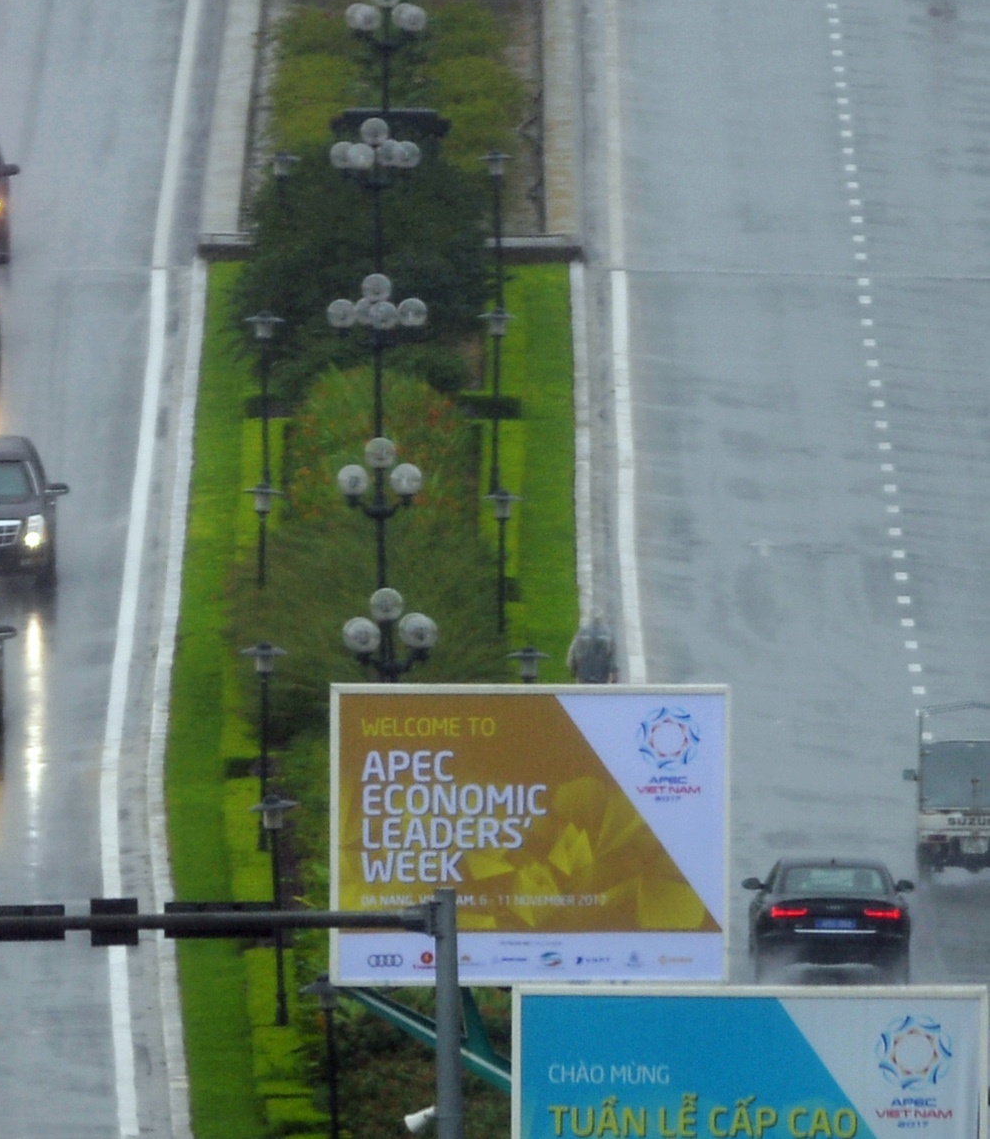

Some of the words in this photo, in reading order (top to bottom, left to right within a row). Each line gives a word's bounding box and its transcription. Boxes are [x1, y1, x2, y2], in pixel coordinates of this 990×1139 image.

[361, 717, 461, 737] WELCOME
[468, 717, 497, 737] TO
[361, 750, 455, 782] APEC
[362, 783, 548, 816] ECONOMIC
[361, 850, 464, 883] WEEK
[514, 894, 576, 906] NOVEMBER
[548, 1059, 605, 1085] CHÀO
[659, 1092, 699, 1138] LỄ
[709, 1094, 779, 1138] CẤP
[788, 1107, 859, 1139] CAO
